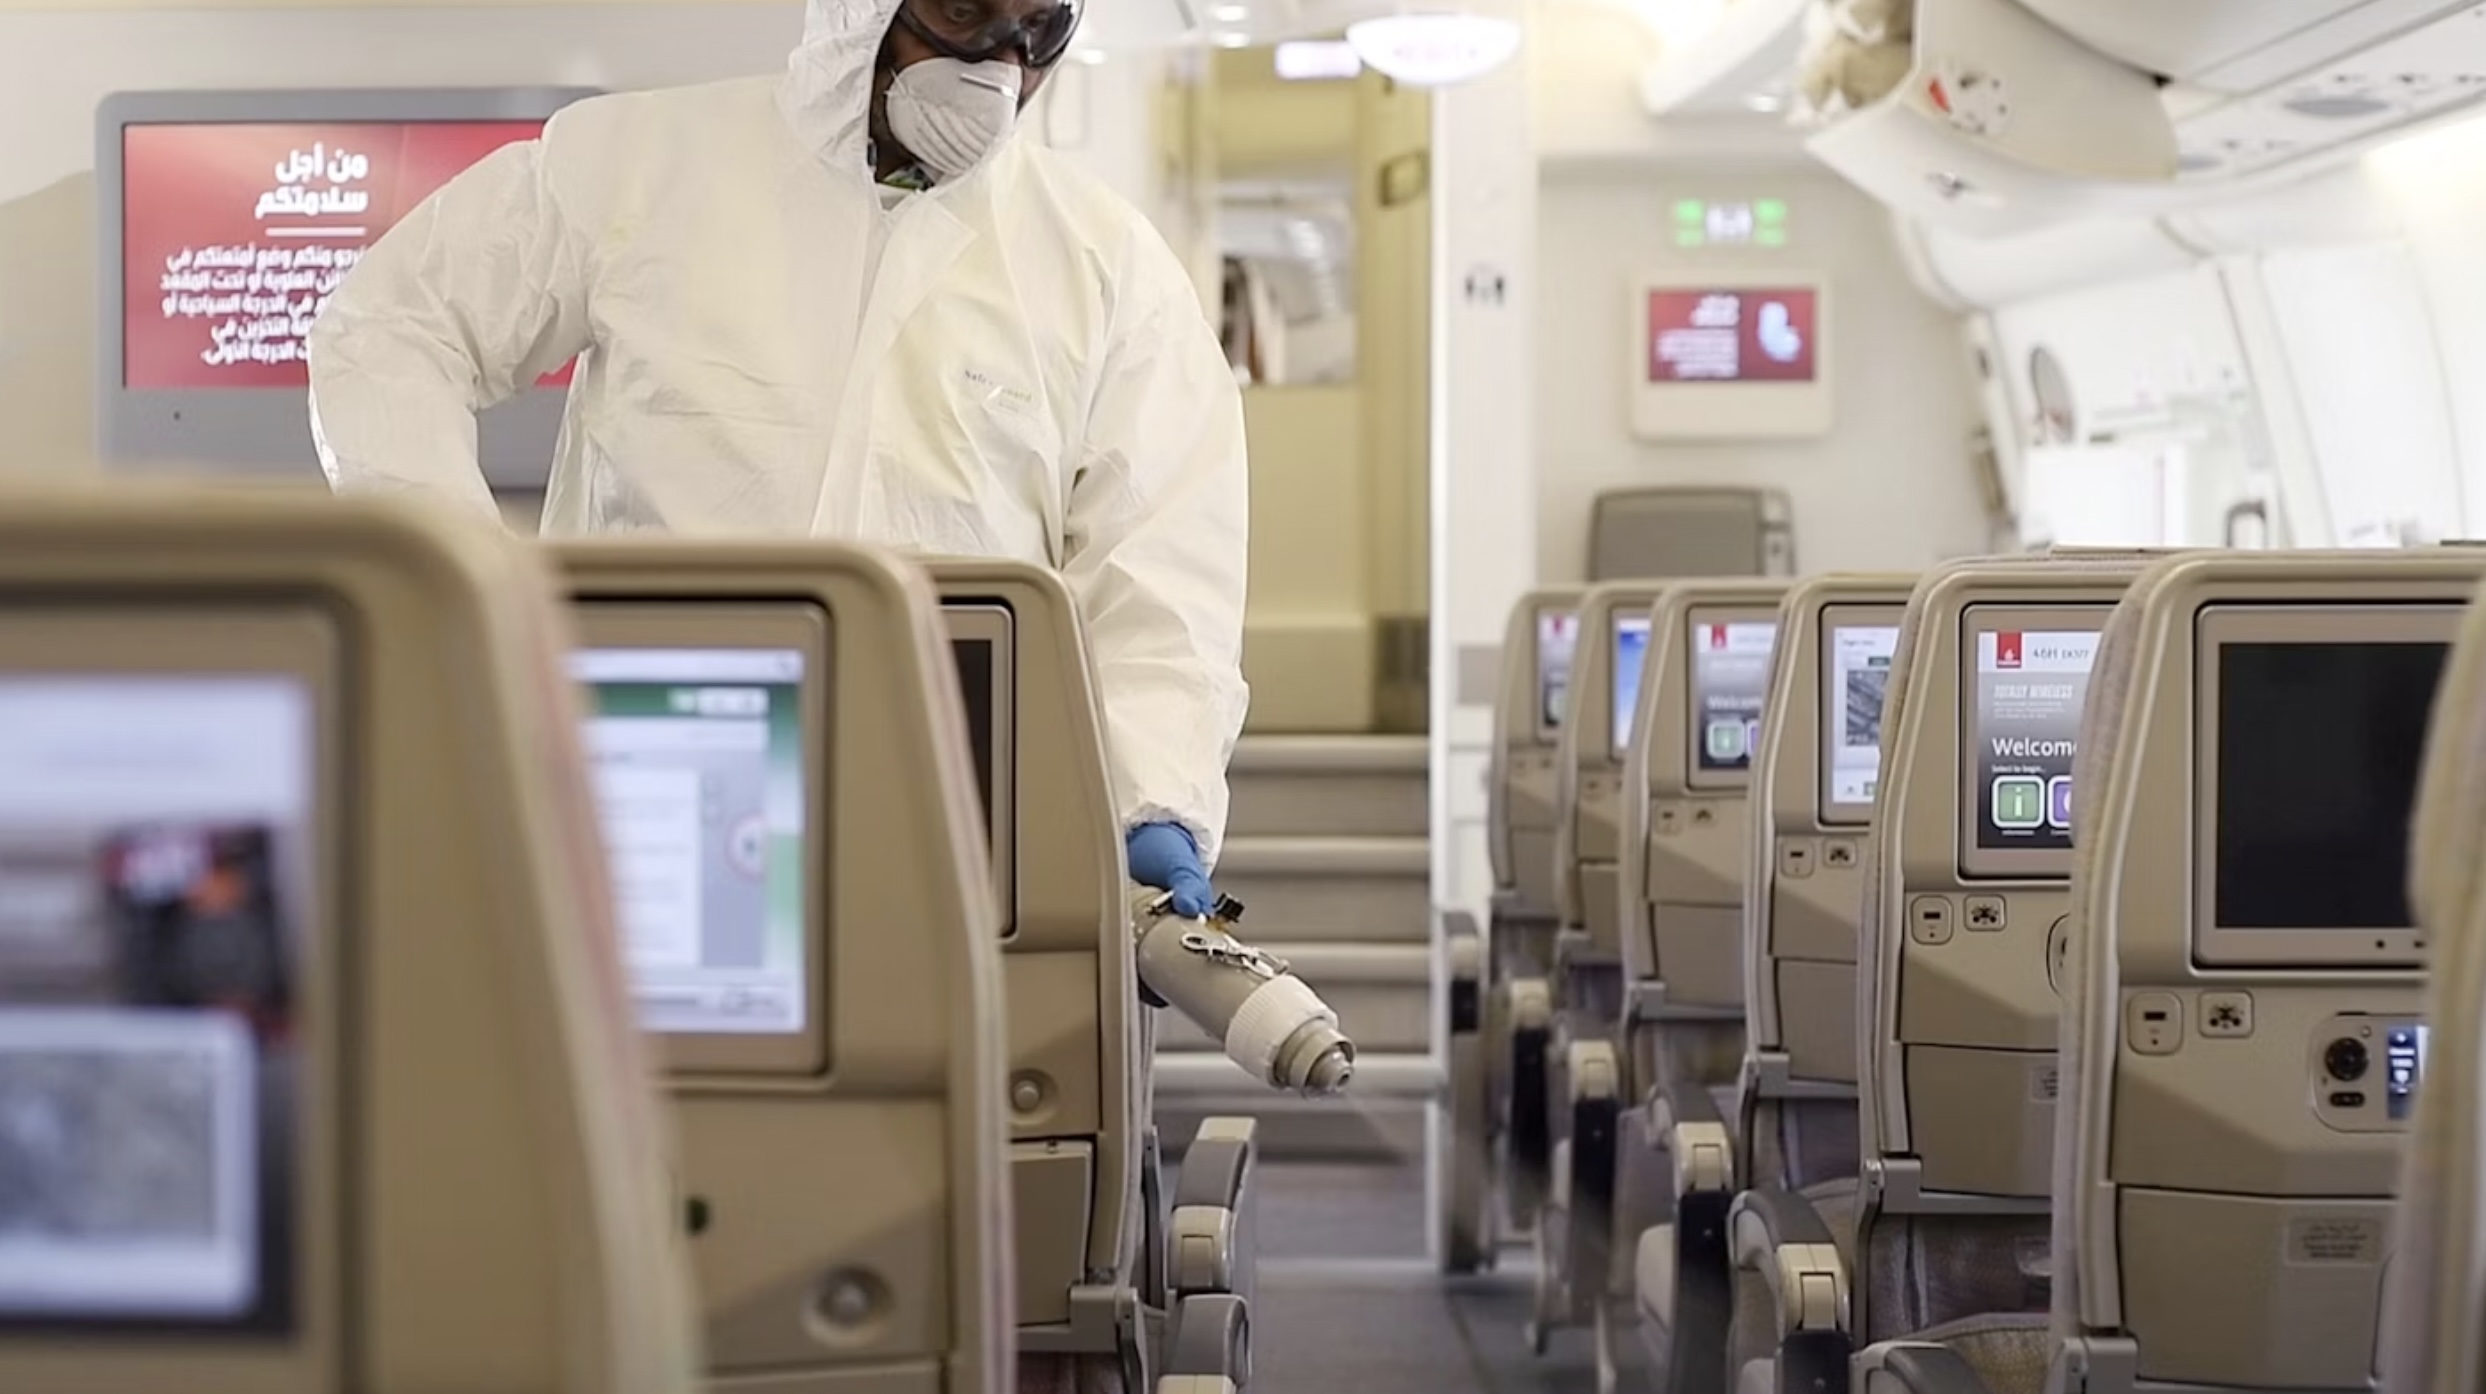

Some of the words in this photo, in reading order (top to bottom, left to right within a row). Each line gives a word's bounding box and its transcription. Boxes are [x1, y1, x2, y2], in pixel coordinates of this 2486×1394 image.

[327, 148, 368, 183] من
[255, 185, 368, 220] سلامتكم
[166, 246, 192, 273] في
[293, 245, 332, 269] منكم
[211, 269, 246, 290] تحت
[287, 293, 314, 318] في
[211, 316, 237, 343] في
[1708, 695, 1763, 711] Welcom
